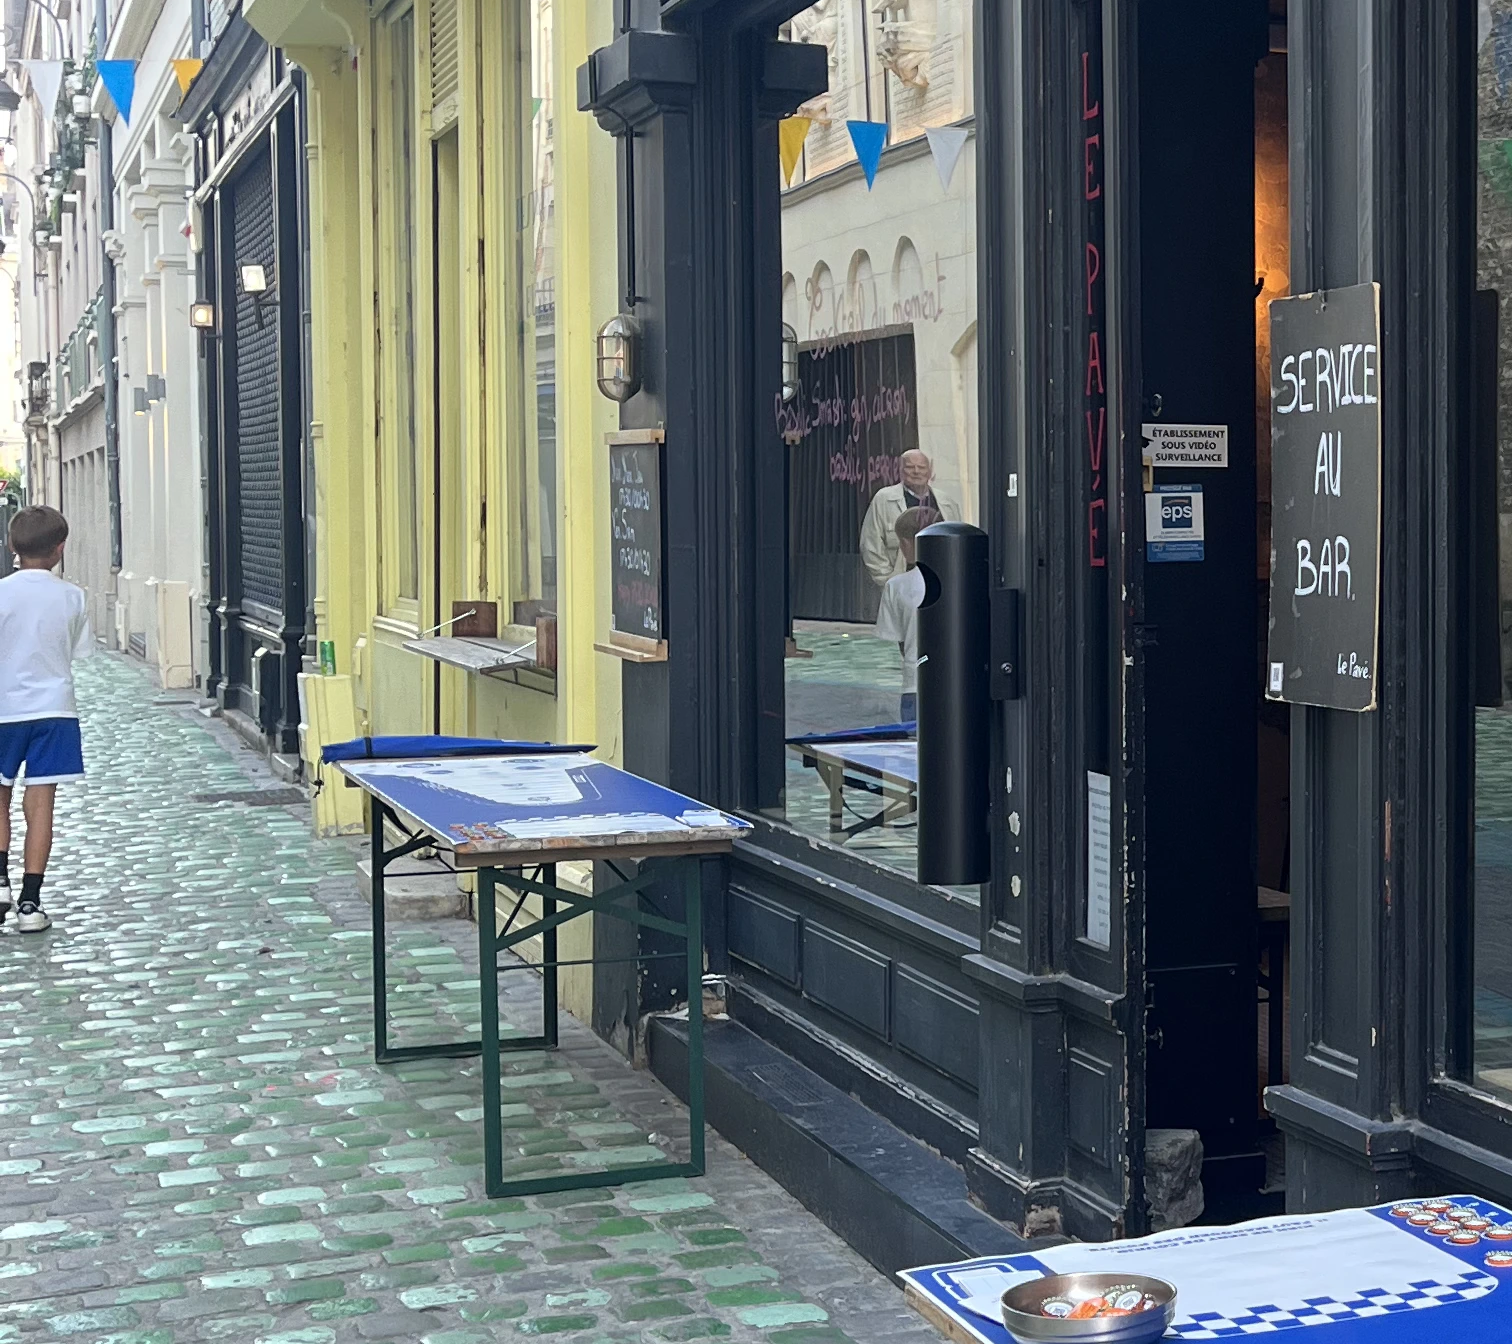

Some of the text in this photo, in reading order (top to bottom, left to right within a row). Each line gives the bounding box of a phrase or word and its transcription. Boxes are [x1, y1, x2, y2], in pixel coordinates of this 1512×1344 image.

[892, 251, 947, 325] moment
[1081, 51, 1106, 568] LE PAVÉ
[1276, 343, 1378, 414] SERVICE
[1151, 427, 1226, 439] ÉTABLISSEMENT
[1161, 440, 1217, 451] SOUS VIDÉO
[1155, 453, 1223, 463] SURVEILLANCE
[1313, 430, 1343, 498] AU
[1161, 505, 1193, 523] eps
